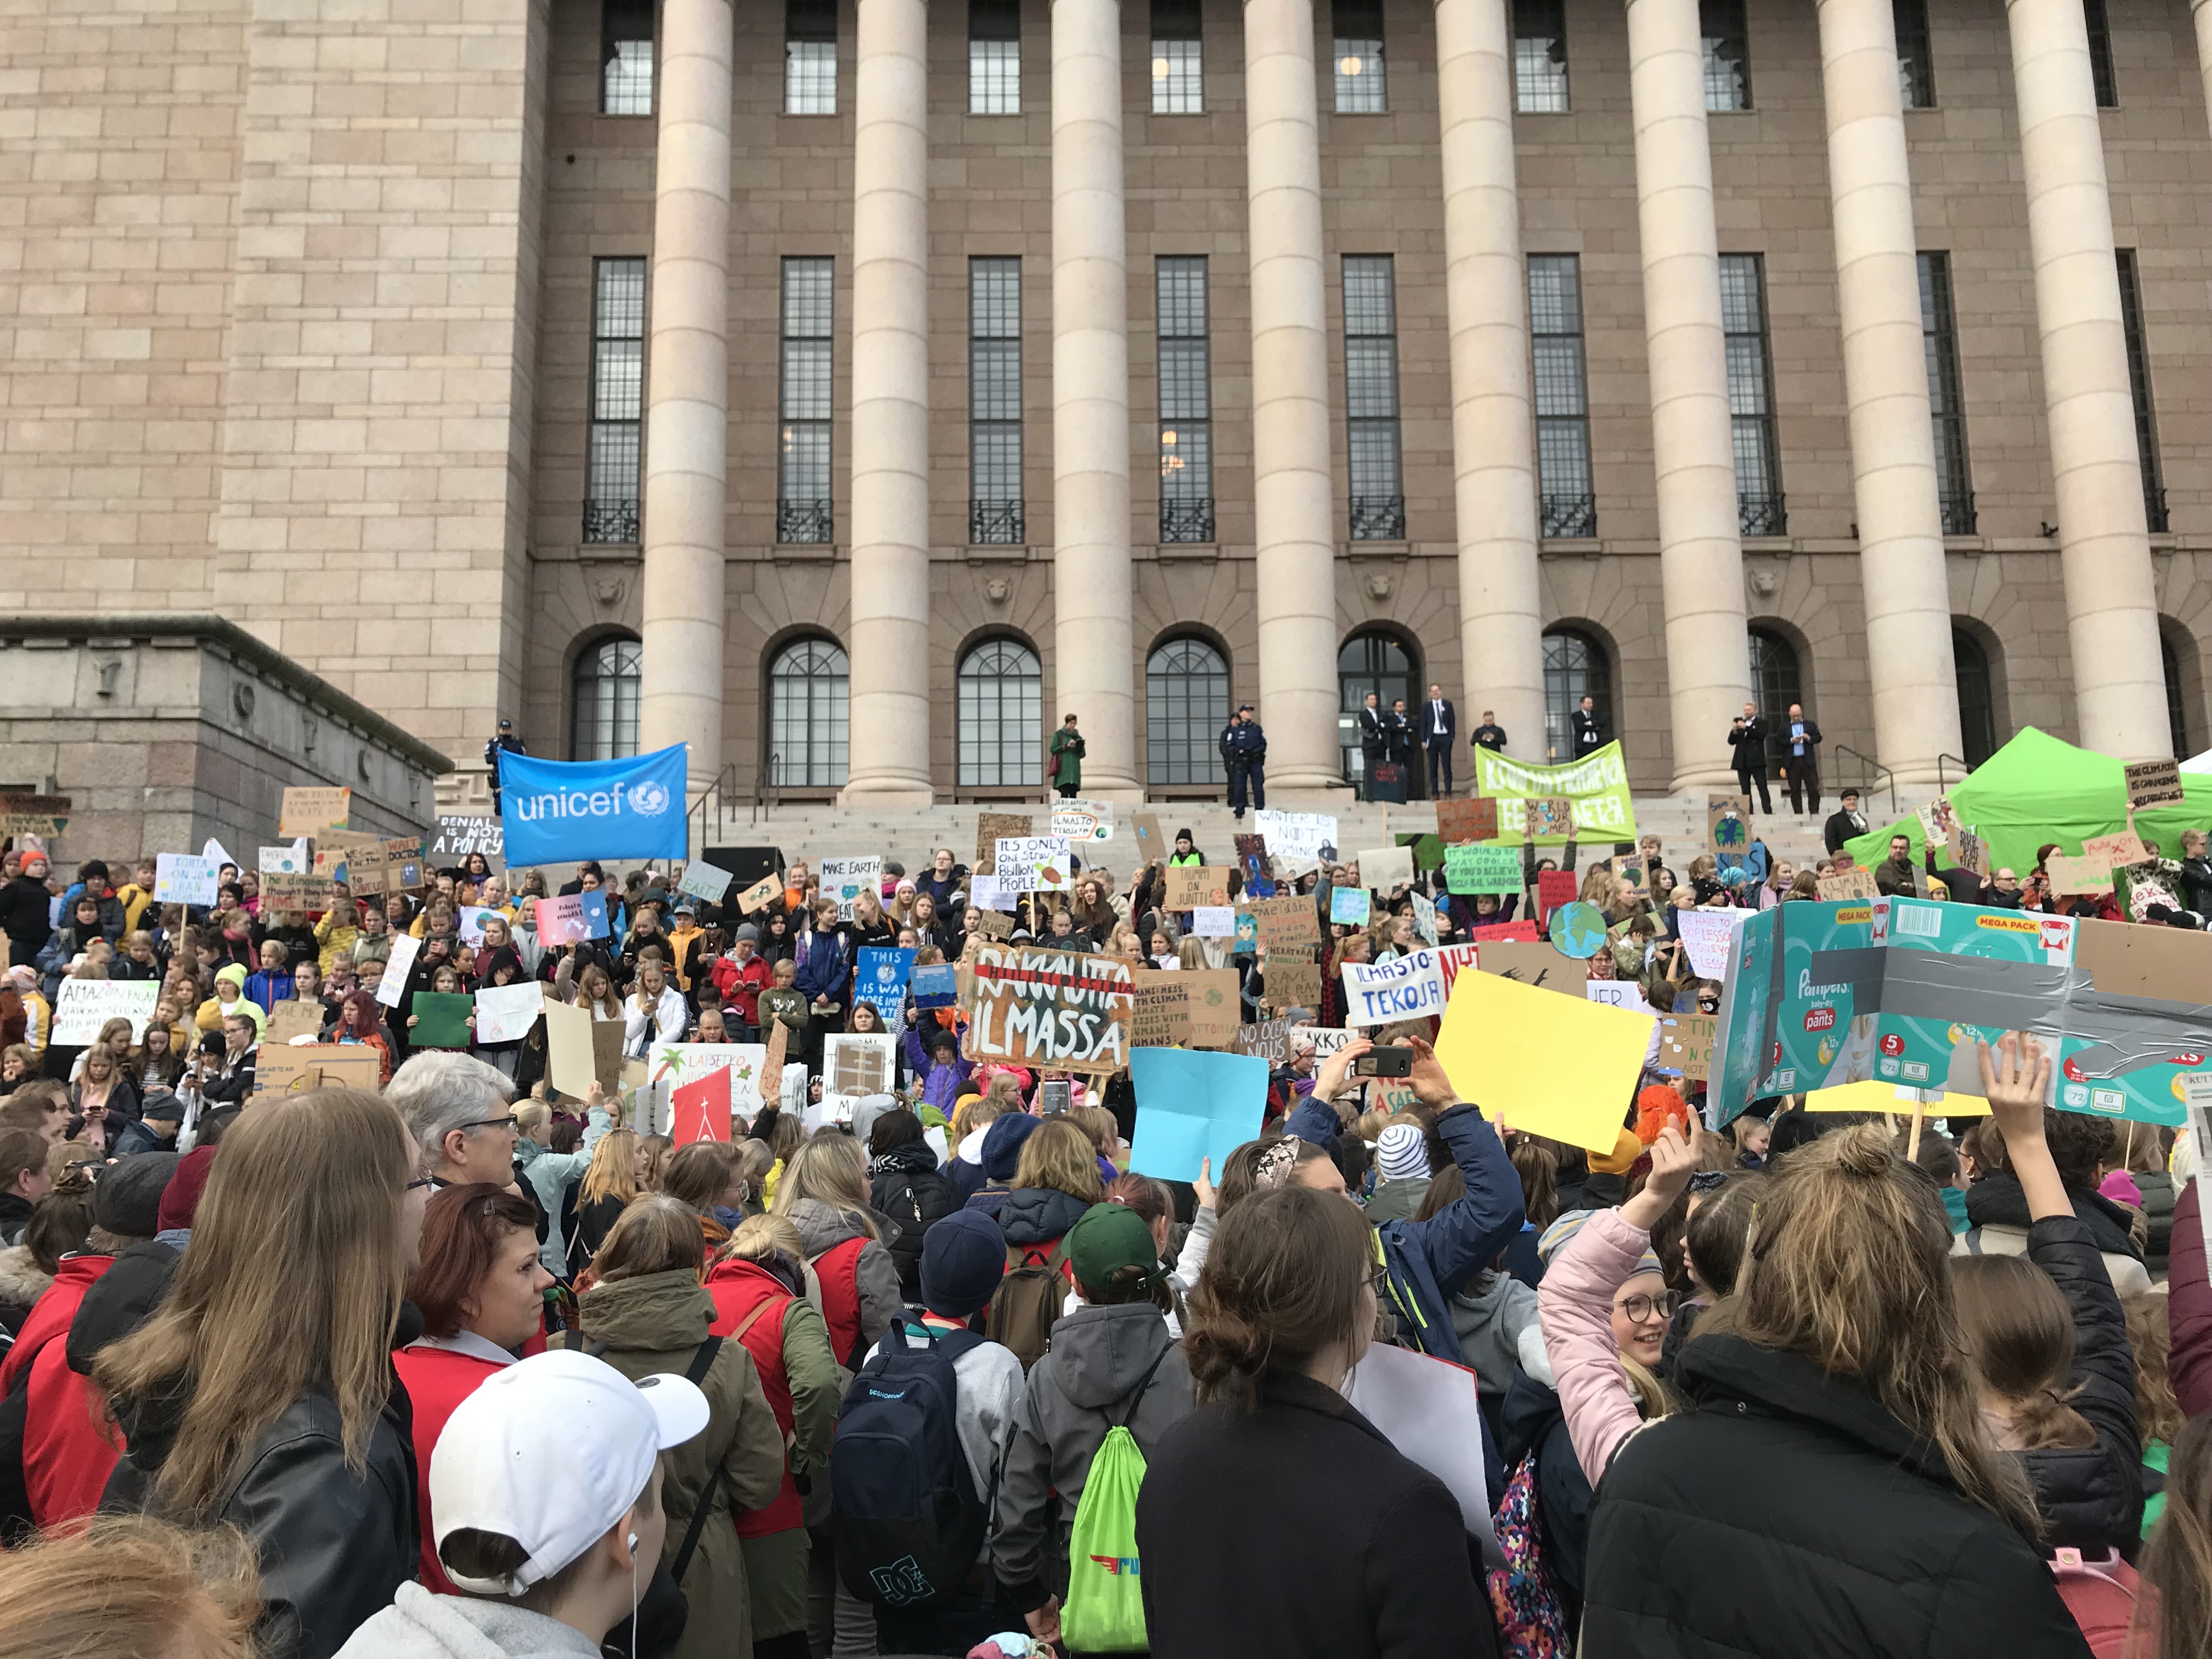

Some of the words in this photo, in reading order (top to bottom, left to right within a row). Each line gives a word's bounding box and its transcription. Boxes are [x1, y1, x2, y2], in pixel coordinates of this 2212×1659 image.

[518, 781, 624, 821] unicef
[441, 816, 494, 828] DENIAL
[1259, 811, 1309, 824] WINTER
[1317, 814, 1330, 827] IS
[1528, 812, 1538, 822] IS
[447, 827, 458, 836] IS
[466, 827, 503, 840] NOT
[1278, 826, 1318, 842] NOT
[387, 838, 418, 850] WAIT
[433, 835, 445, 853] A
[1028, 838, 1065, 850] ONLY
[1269, 842, 1317, 857] COMING
[388, 848, 421, 861] DOCTOR
[999, 854, 1018, 862] ONE
[823, 862, 845, 874] MAKE
[849, 861, 880, 874] EARTH
[682, 878, 725, 899] EARTH
[1000, 877, 1035, 891] PEOPLE
[1187, 882, 1200, 891] ON
[1824, 873, 1872, 891] CLIMATE
[261, 895, 296, 909] TIME
[1177, 892, 1207, 905] JUNTTI
[839, 903, 854, 919] EAT
[1838, 912, 1854, 921] MEGA
[1855, 911, 1870, 919] PACK
[981, 919, 1005, 934] PLANET
[1679, 913, 1692, 924] WE
[1695, 913, 1716, 927] HAVE
[1720, 918, 1730, 927] TO
[1980, 917, 2007, 928] MEGA
[2010, 922, 2036, 931] PACK
[1682, 926, 1699, 937] SKIP
[464, 935, 479, 944] WE
[871, 952, 901, 963] THIS
[1718, 944, 1729, 957] YO
[1356, 952, 1432, 982] ILMASTO-
[1701, 956, 1727, 970] LESSO
[1269, 970, 1307, 986] SAVE
[63, 985, 126, 1002] AMAZON
[863, 983, 874, 993] IS
[879, 984, 906, 994] WAY
[1135, 986, 1159, 996] MANS:
[1161, 985, 1182, 994] MESS
[1267, 985, 1289, 997] OUR
[855, 995, 883, 1006] MORE
[1133, 998, 1148, 1006] ITH
[1150, 993, 1188, 1004] CLIMATE
[1362, 980, 1440, 1017] TEKOJA
[1810, 1000, 1833, 1008] baby-dry
[1133, 1016, 1159, 1025] ESSES
[1163, 1013, 1188, 1022] WITH
[1807, 1013, 1833, 1031] pants
[973, 999, 1121, 1066] ILMASSA
[1240, 1026, 1257, 1043] NO
[1262, 1020, 1290, 1040] OCEAN
[1689, 1019, 1717, 1037] TIM
[1270, 1038, 1285, 1058] US
[1886, 1035, 1898, 1049] 5
[689, 1054, 746, 1068] LAPSETKO
[1684, 1064, 1704, 1074] NOT
[1886, 1064, 1896, 1073] 72
[2072, 1092, 2084, 1101] 72
[1375, 1093, 1389, 1116] A
